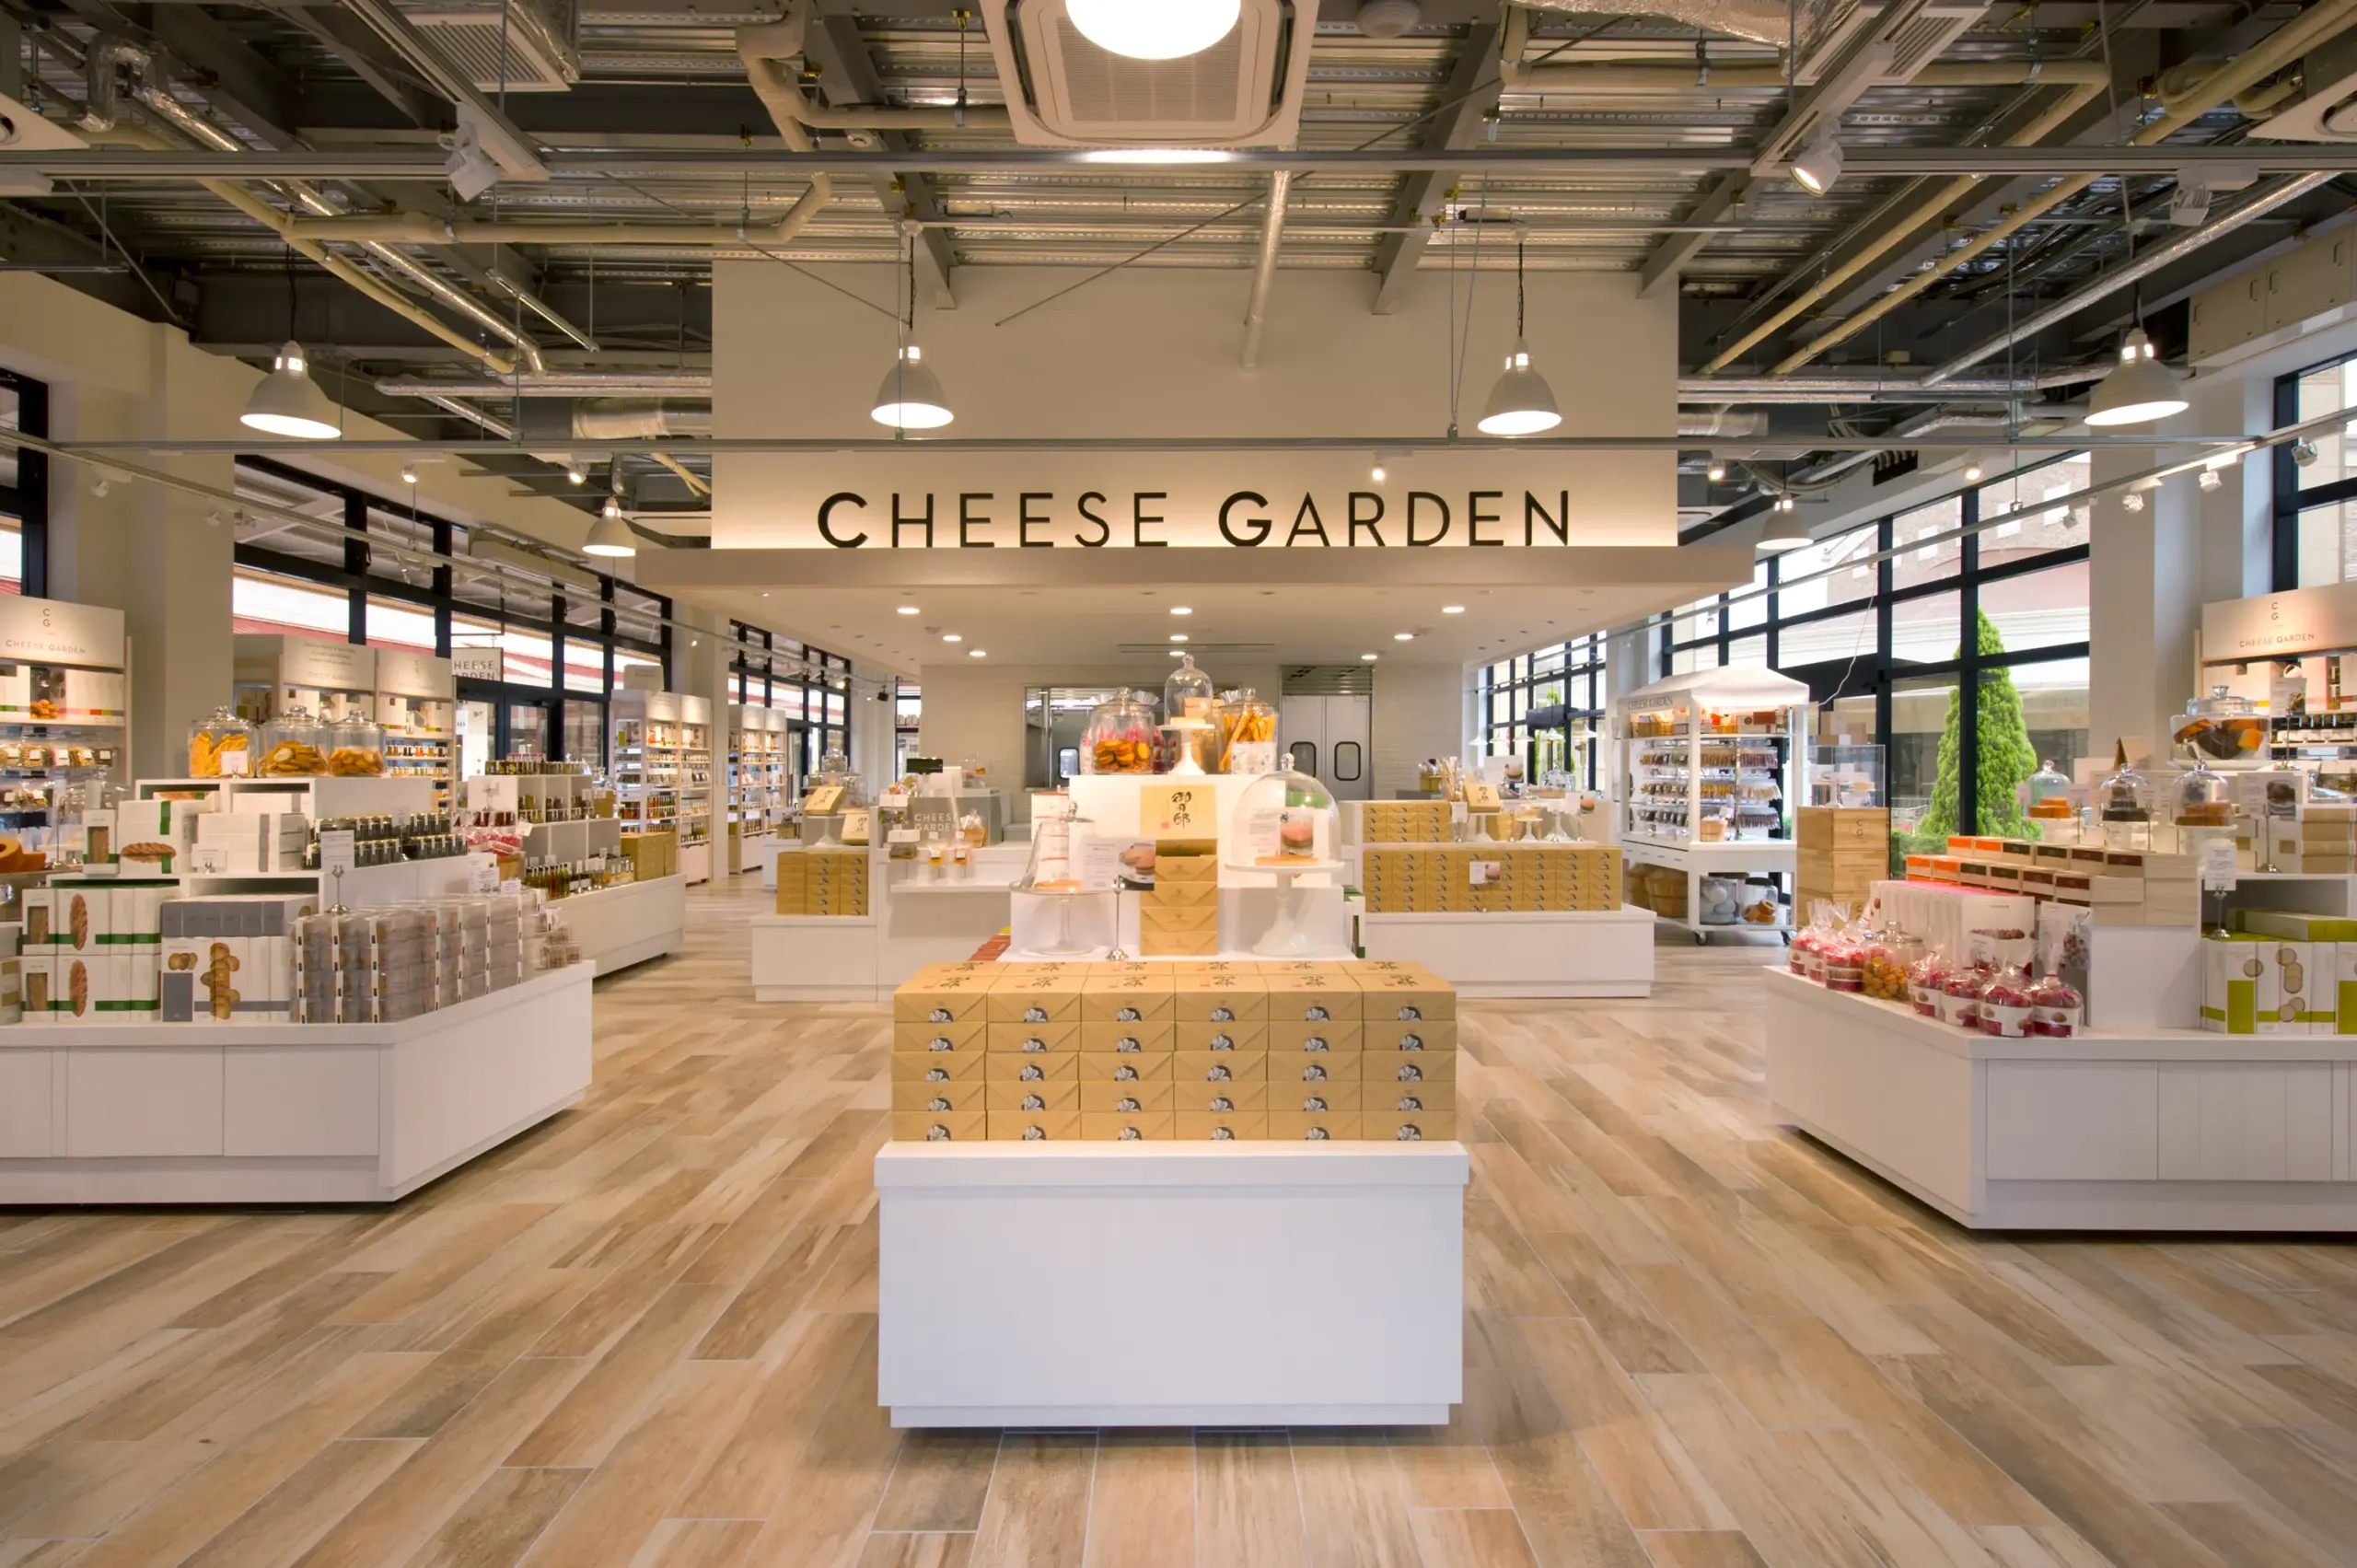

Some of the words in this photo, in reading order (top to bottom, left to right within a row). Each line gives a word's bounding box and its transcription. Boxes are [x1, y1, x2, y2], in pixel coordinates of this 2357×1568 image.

[818, 491, 1168, 548] CHEESE
[1218, 490, 1569, 547] GARDEN
[6, 639, 43, 650] CHEESE
[49, 643, 86, 654] GARDEN
[2239, 635, 2272, 647] CHEESE
[2277, 633, 2315, 644] GARDEN
[453, 660, 495, 670] HEESE
[914, 812, 952, 822] CHEES
